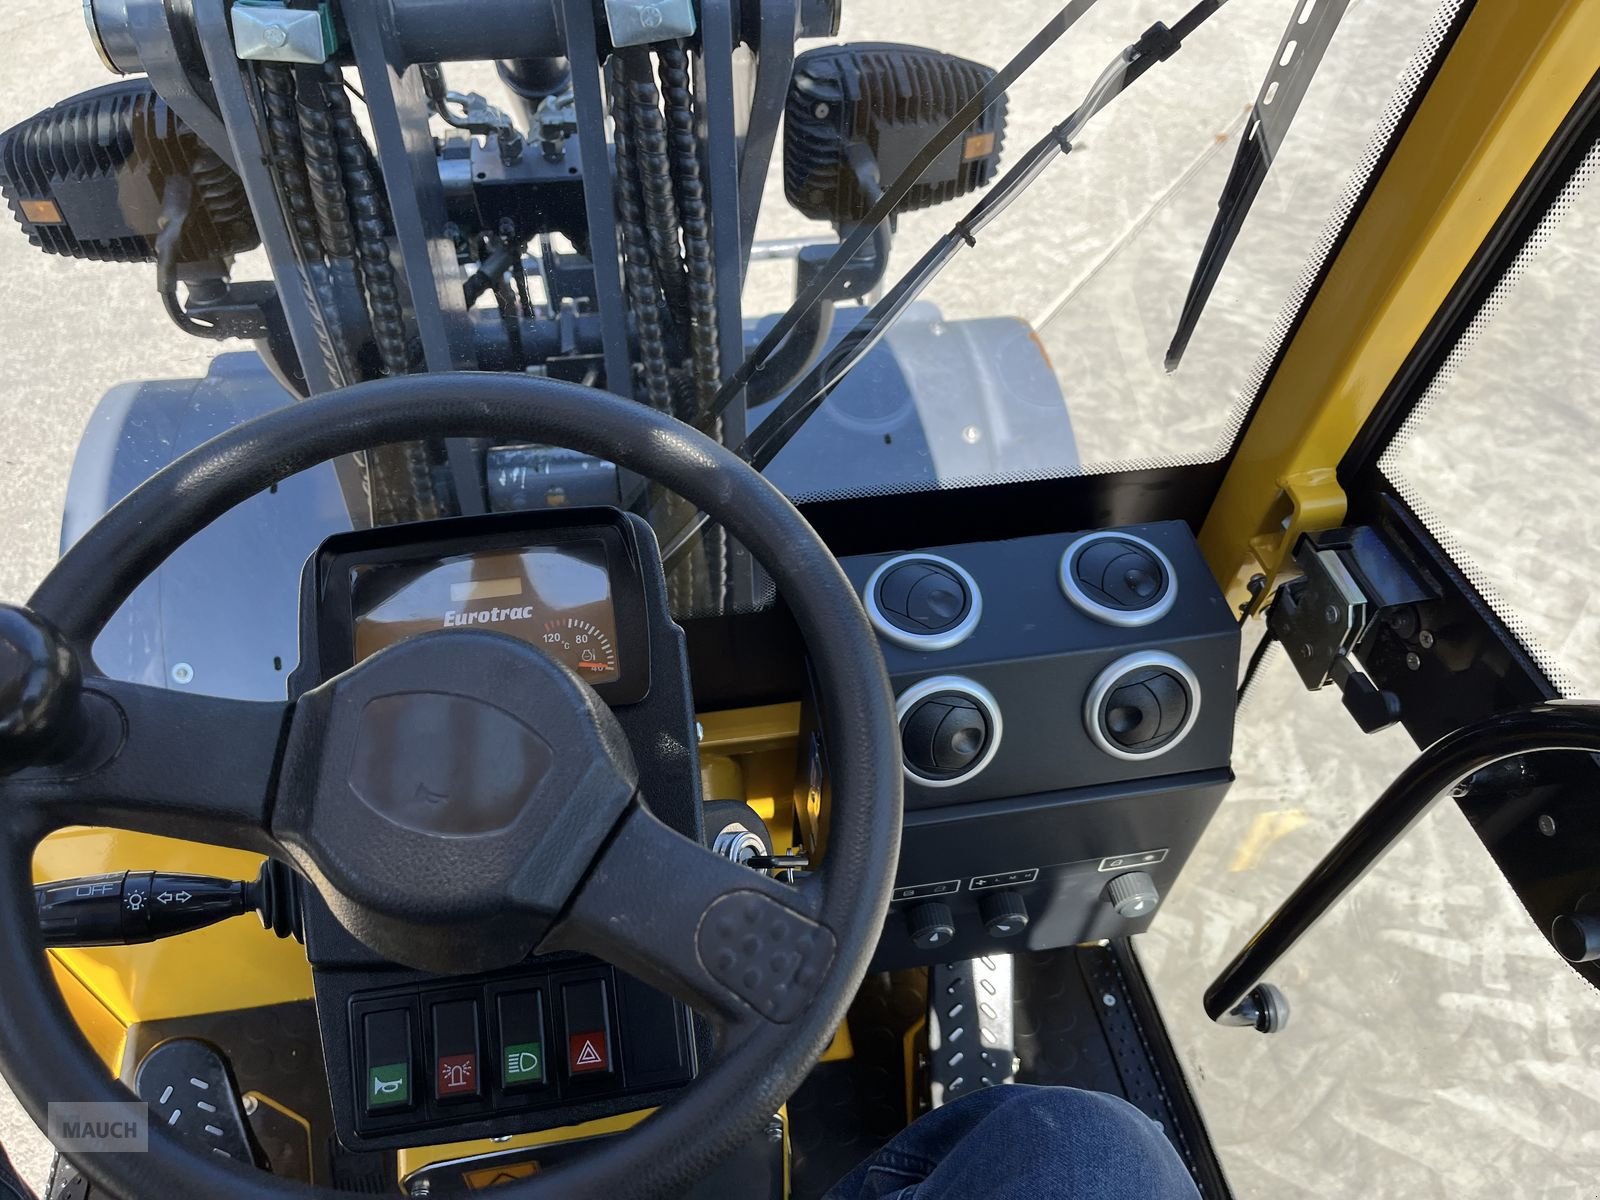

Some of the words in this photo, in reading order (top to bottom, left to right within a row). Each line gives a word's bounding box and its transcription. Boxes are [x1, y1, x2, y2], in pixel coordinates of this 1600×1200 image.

[443, 606, 534, 627] Eurotrac
[543, 632, 561, 643] 120
[575, 634, 588, 644] 80
[76, 883, 114, 897] OFF
